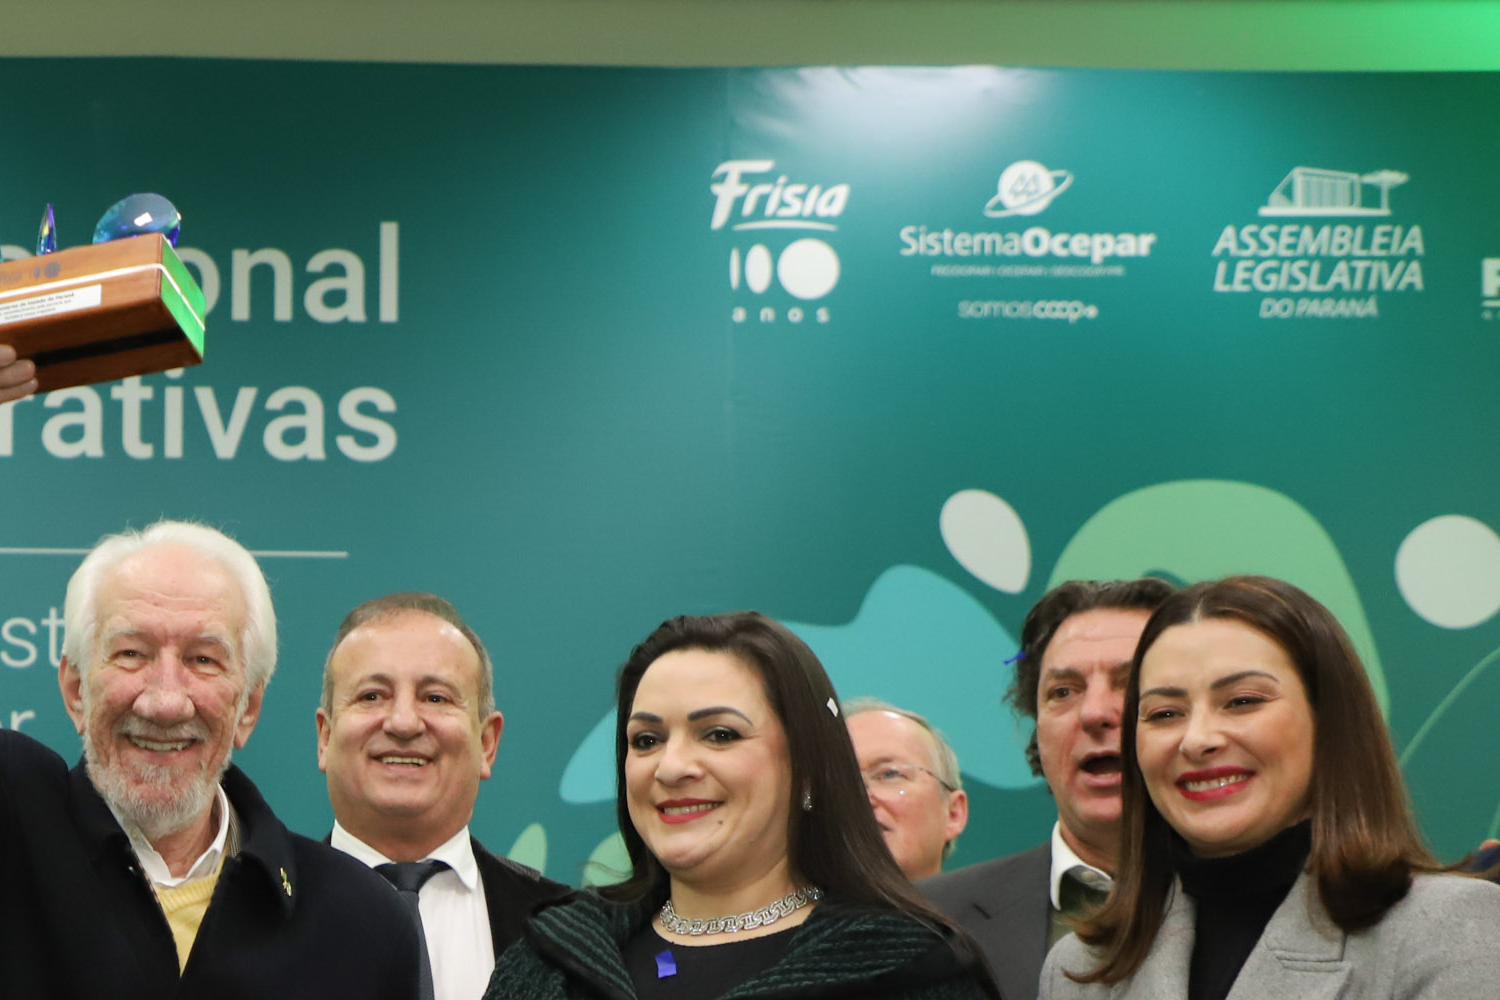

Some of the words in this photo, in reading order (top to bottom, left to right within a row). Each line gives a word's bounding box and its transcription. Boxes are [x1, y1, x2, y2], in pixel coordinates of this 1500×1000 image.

[900, 226, 1157, 264] SistemaOcepar
[1212, 225, 1425, 256] ASSEMBLEIA
[1213, 260, 1425, 292] LEGISLATIVA
[731, 307, 830, 323] anos
[1259, 298, 1294, 318] DO
[1296, 294, 1379, 318] PARANÁ
